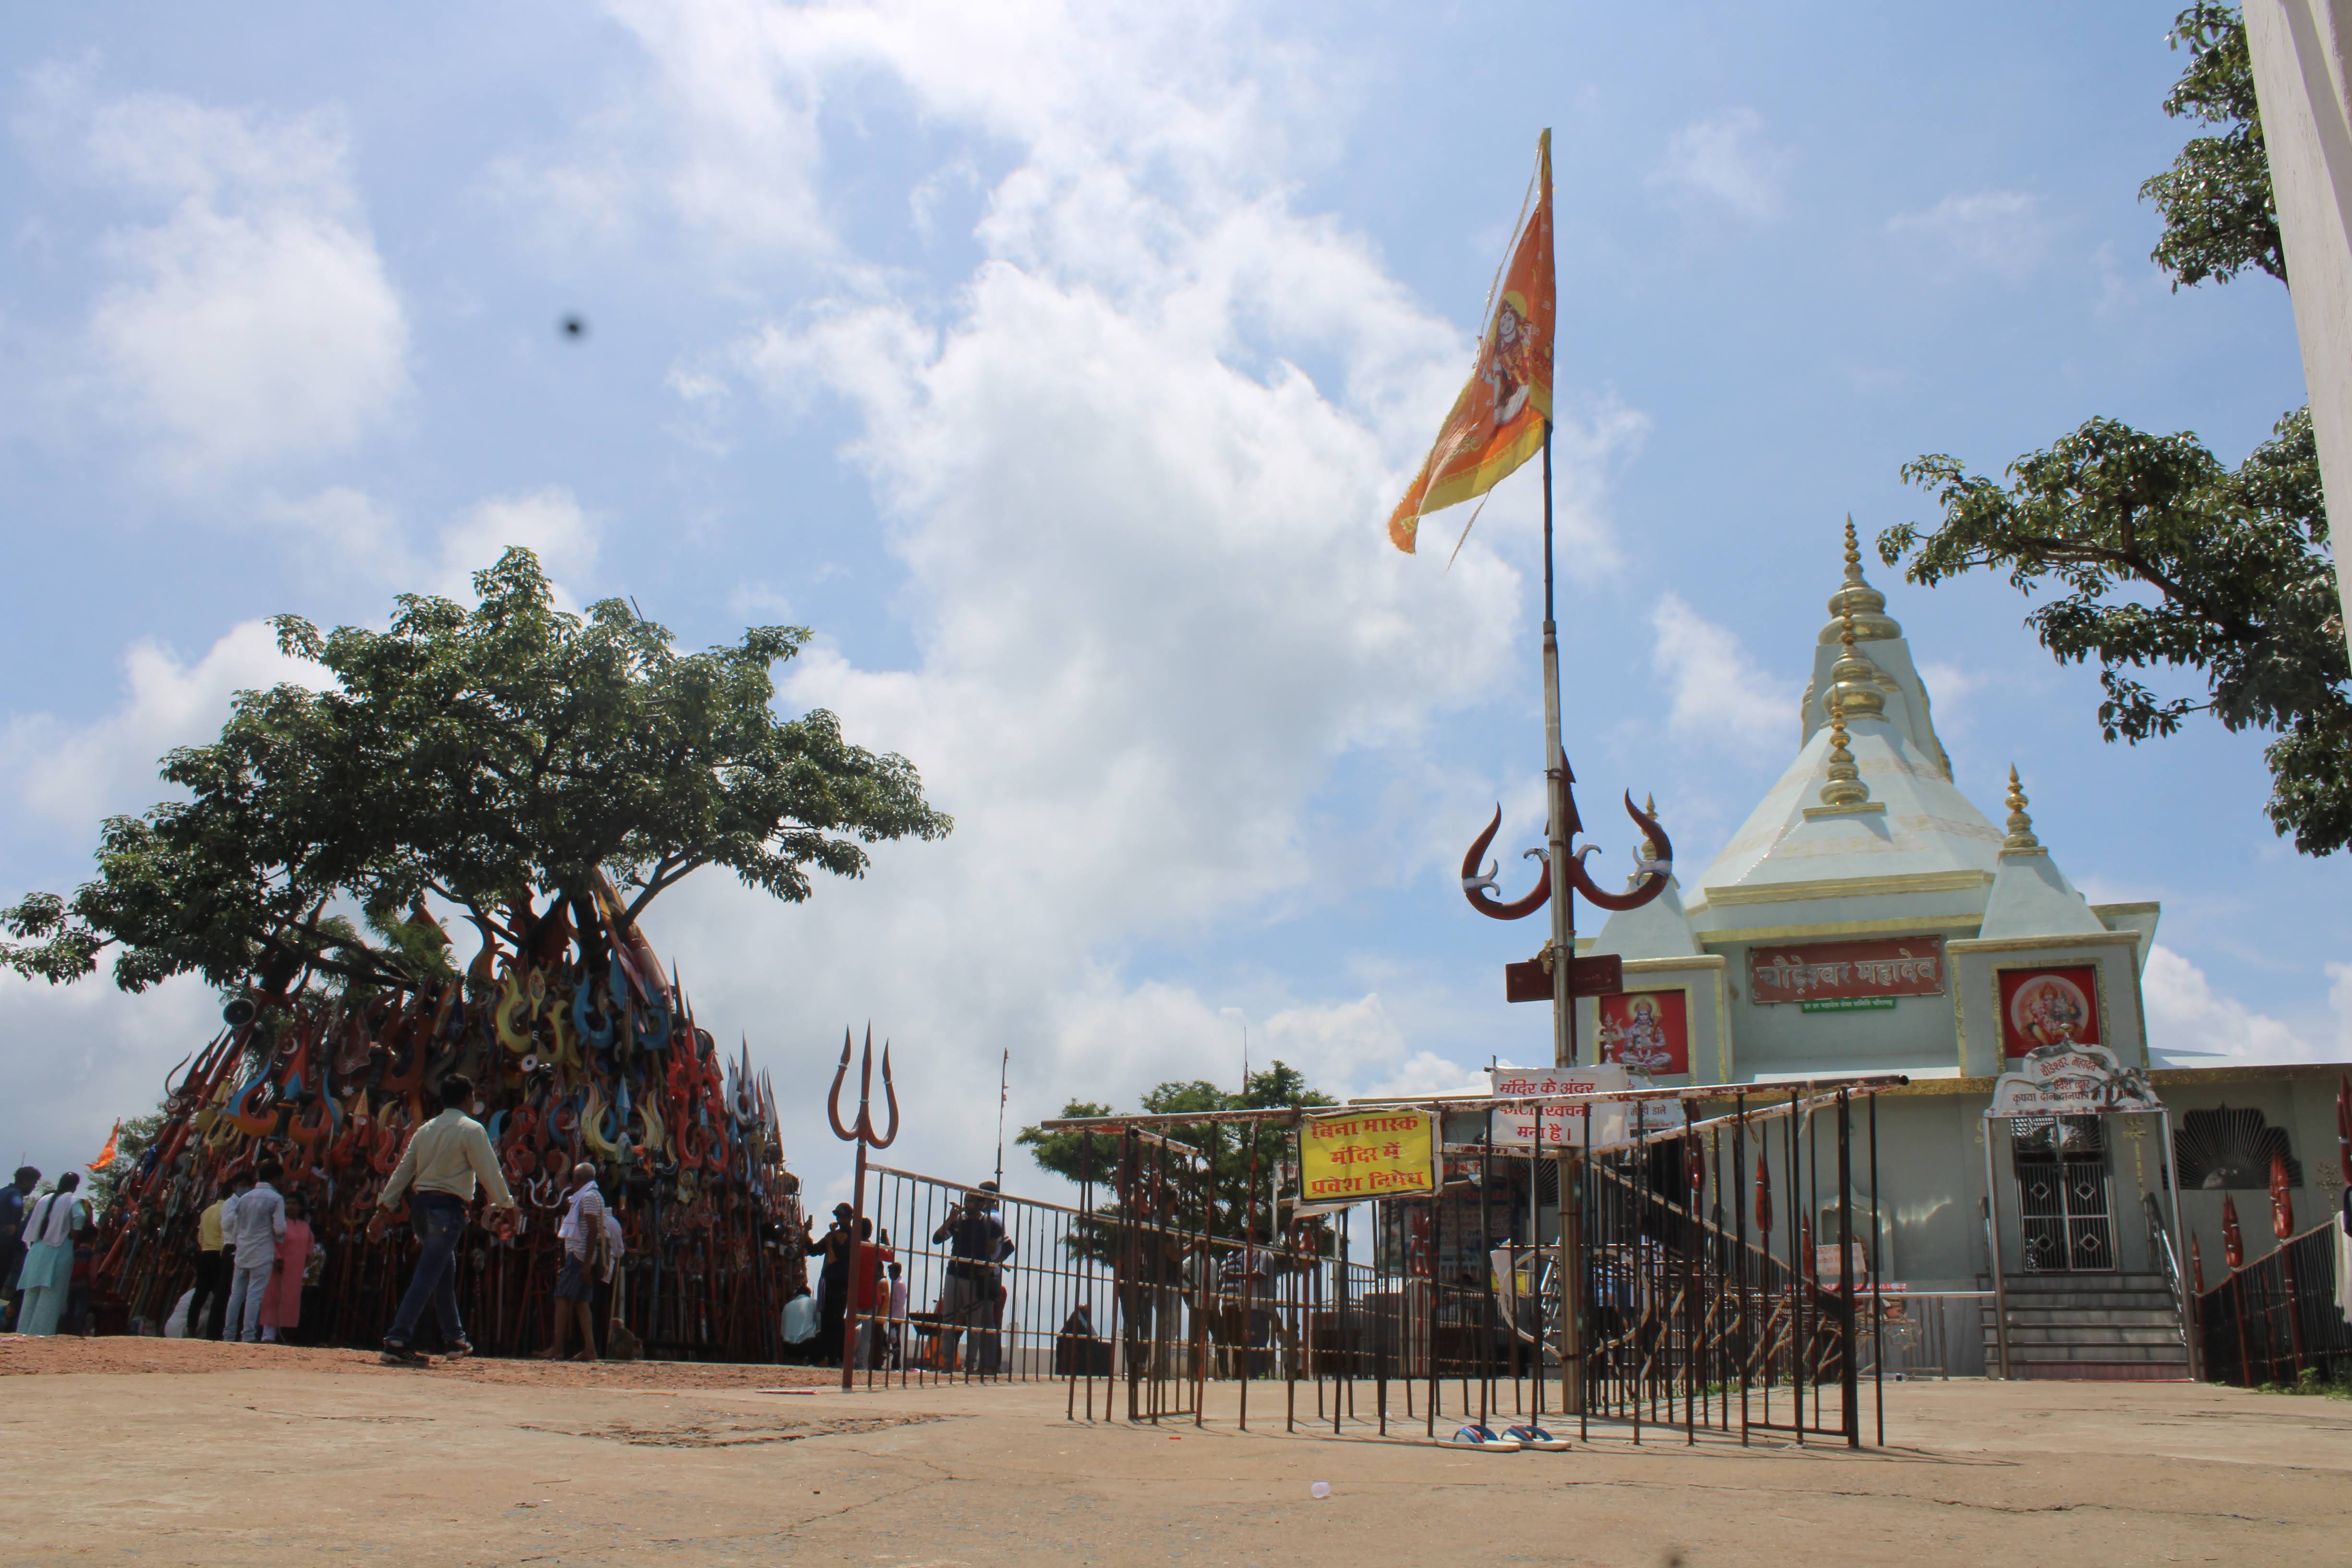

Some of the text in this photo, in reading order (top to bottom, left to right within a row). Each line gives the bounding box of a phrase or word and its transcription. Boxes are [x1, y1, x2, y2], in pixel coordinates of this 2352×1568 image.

[1855, 948, 1937, 986] महादेव
[2072, 1057, 2098, 1072] महादेव
[1500, 1078, 1595, 1095] मंदिर के अंदर
[2013, 1094, 2036, 1105] कृपया
[1311, 1116, 1418, 1139] बिना मास्क
[1517, 1126, 1546, 1138] मना
[1549, 1123, 1562, 1142] है
[1330, 1142, 1400, 1165] मंदिर में
[1310, 1169, 1425, 1194] प्रवेश निषेध
